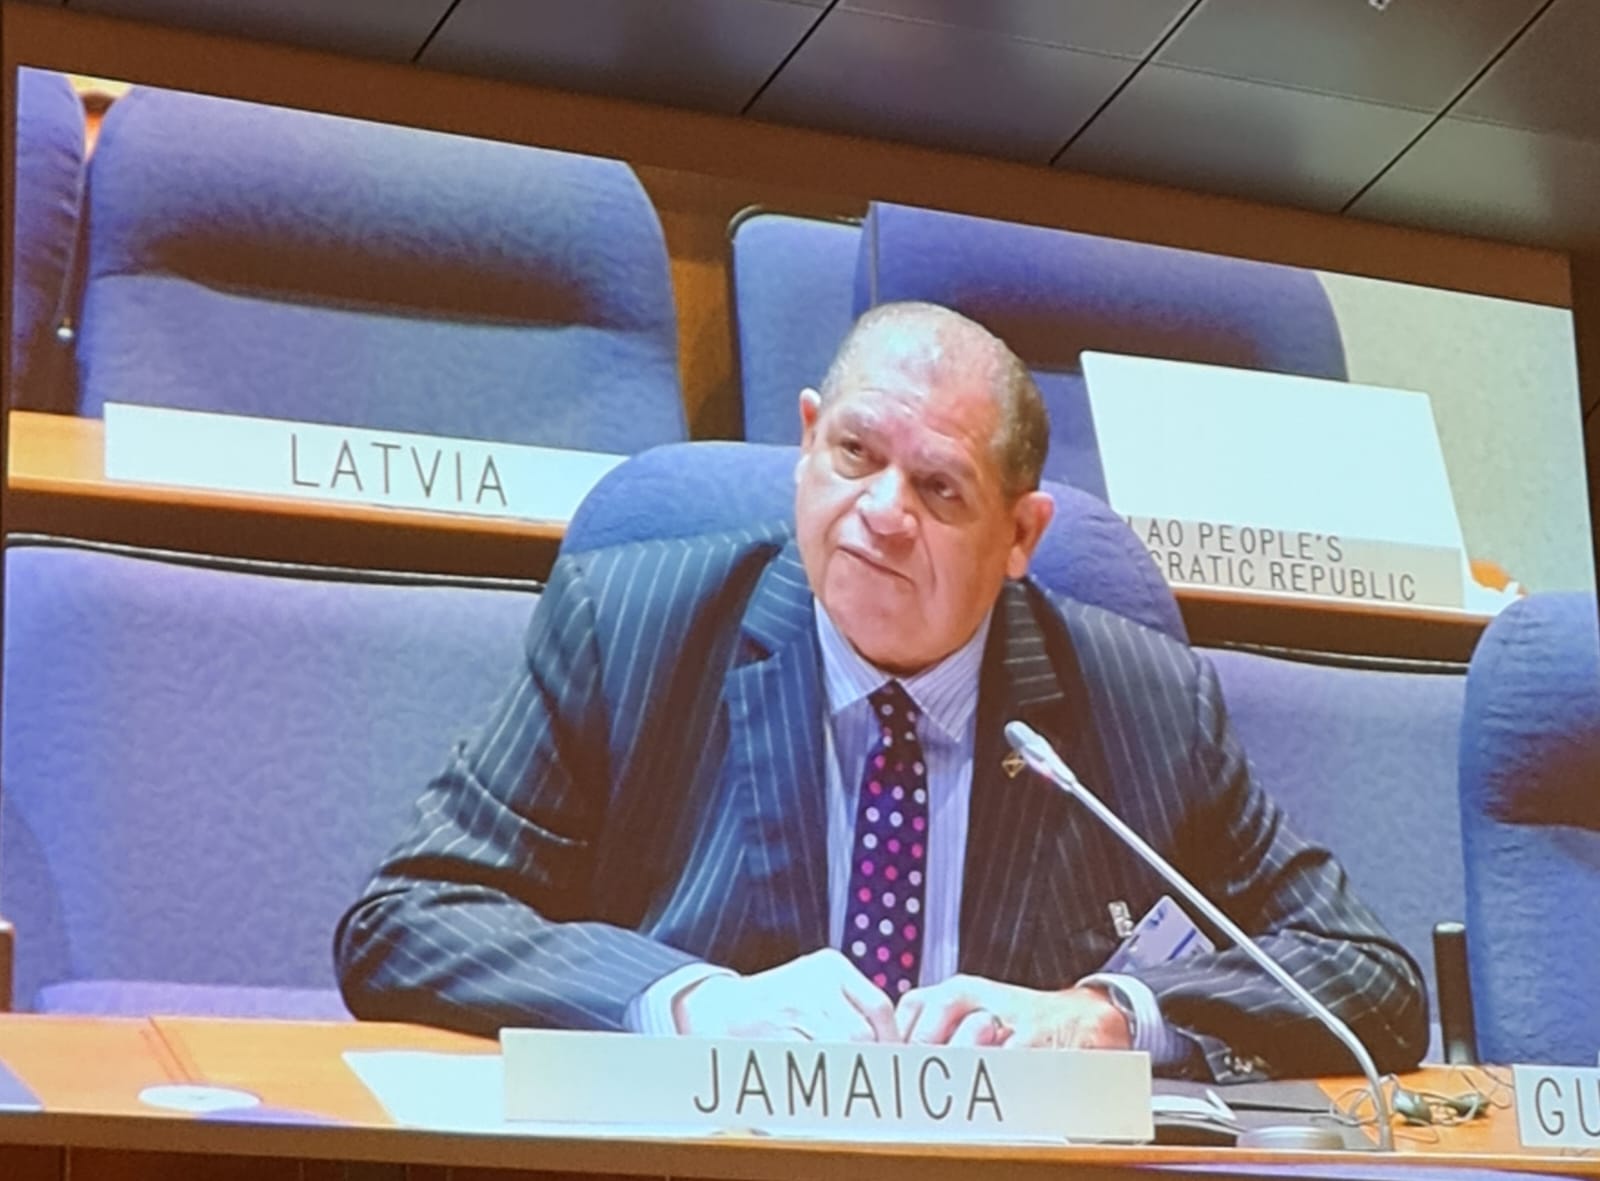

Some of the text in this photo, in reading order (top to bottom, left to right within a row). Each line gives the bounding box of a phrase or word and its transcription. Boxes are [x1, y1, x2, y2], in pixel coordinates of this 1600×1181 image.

[291, 433, 507, 507] LATVIA
[1198, 521, 1343, 562] PEOPLE'S
[1269, 561, 1416, 601] REPUBLIC
[693, 1047, 1003, 1122] JAMAICA
[1535, 1077, 1600, 1137] GU
